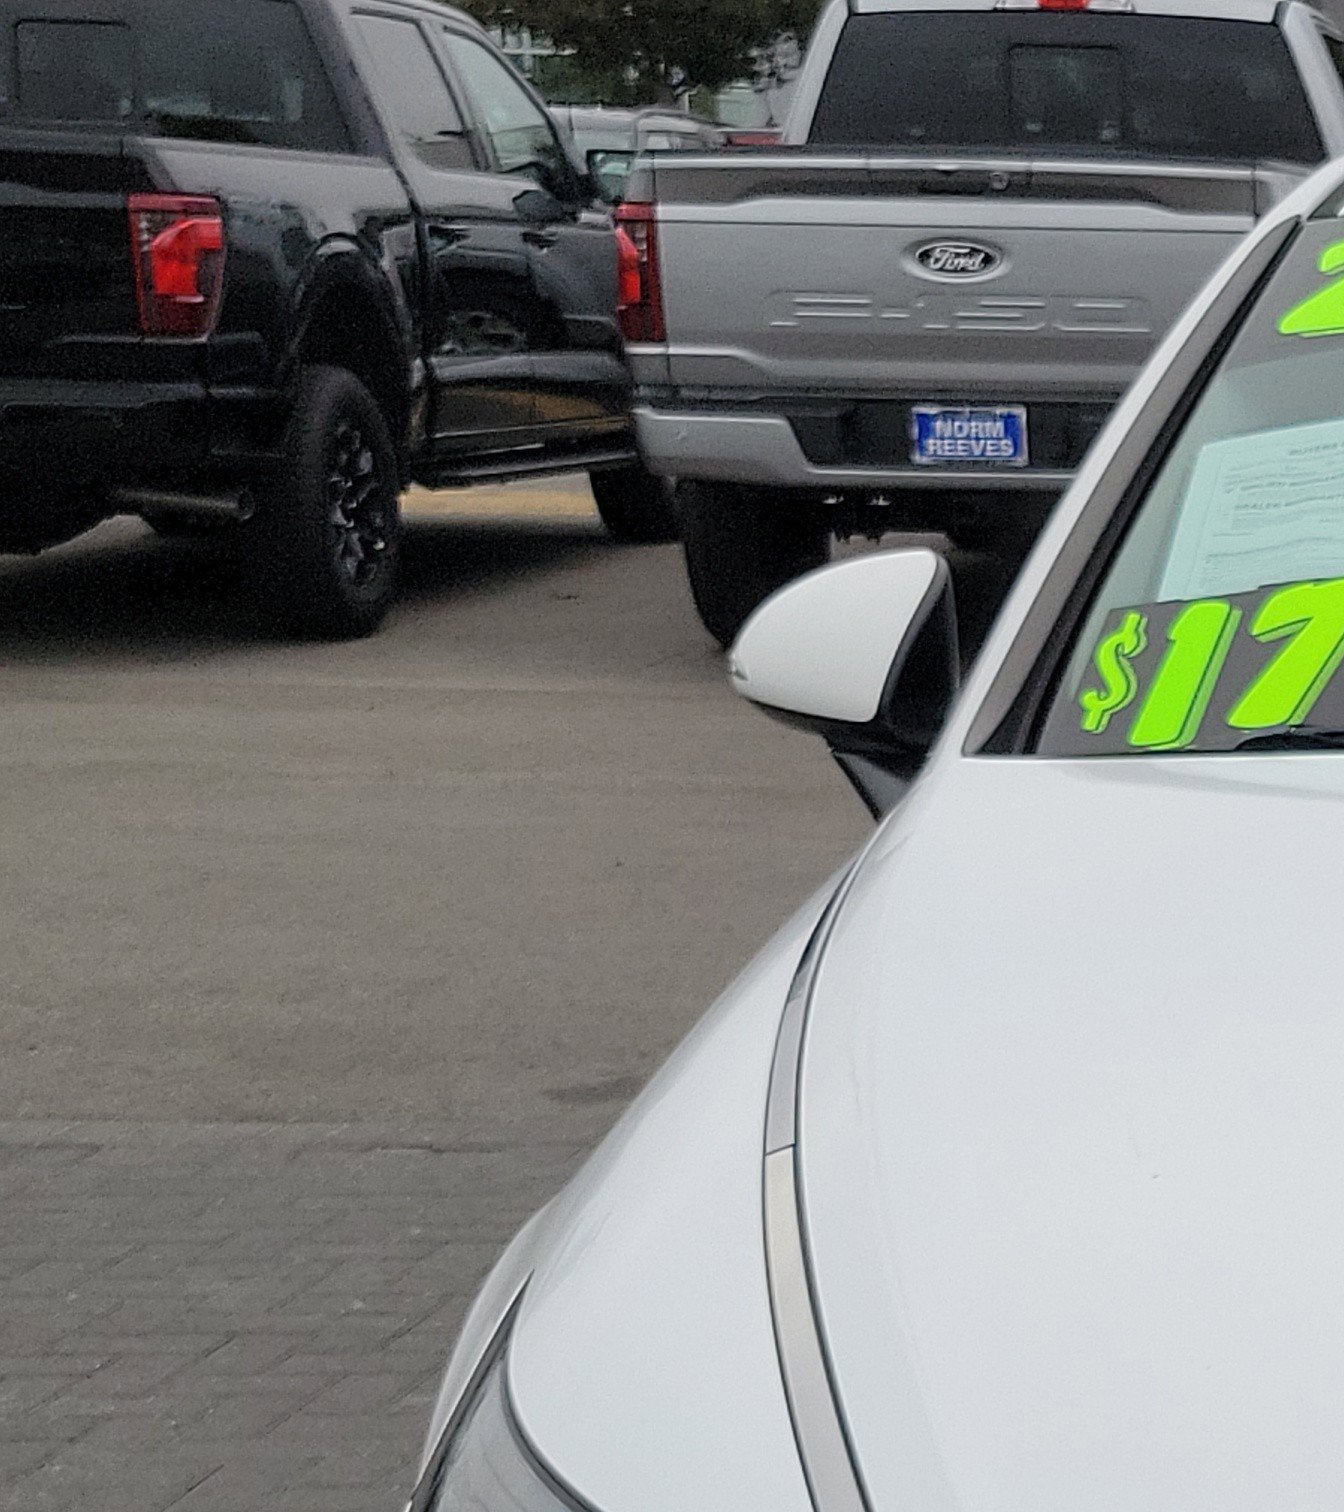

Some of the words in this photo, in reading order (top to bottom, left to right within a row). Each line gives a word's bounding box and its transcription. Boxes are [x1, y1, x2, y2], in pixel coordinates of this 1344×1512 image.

[929, 246, 985, 271] Ford
[934, 419, 1006, 439] NORM
[925, 438, 1015, 458] REEVES
